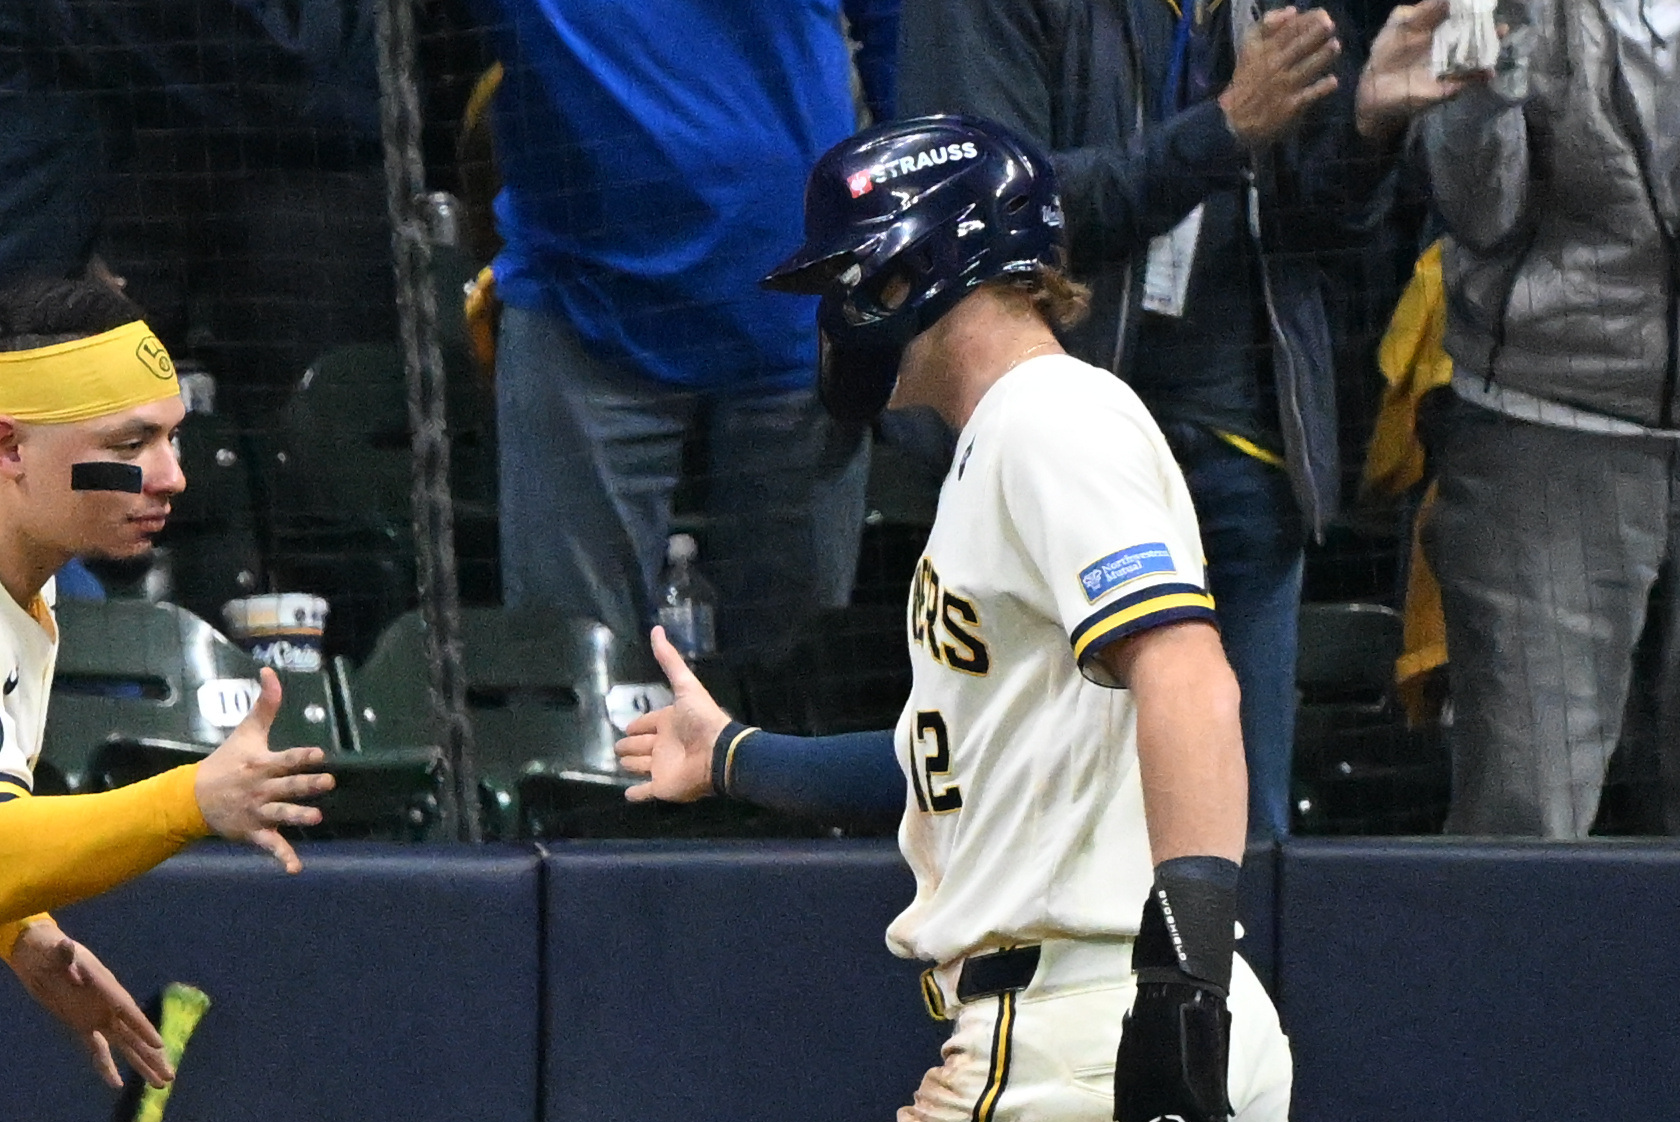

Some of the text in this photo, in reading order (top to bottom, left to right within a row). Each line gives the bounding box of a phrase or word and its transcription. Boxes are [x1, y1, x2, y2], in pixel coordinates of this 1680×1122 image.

[870, 142, 978, 184] STRAUSS
[1101, 549, 1171, 574] Northwestern
[1104, 560, 1143, 582] Mutual
[219, 689, 251, 714] 10
